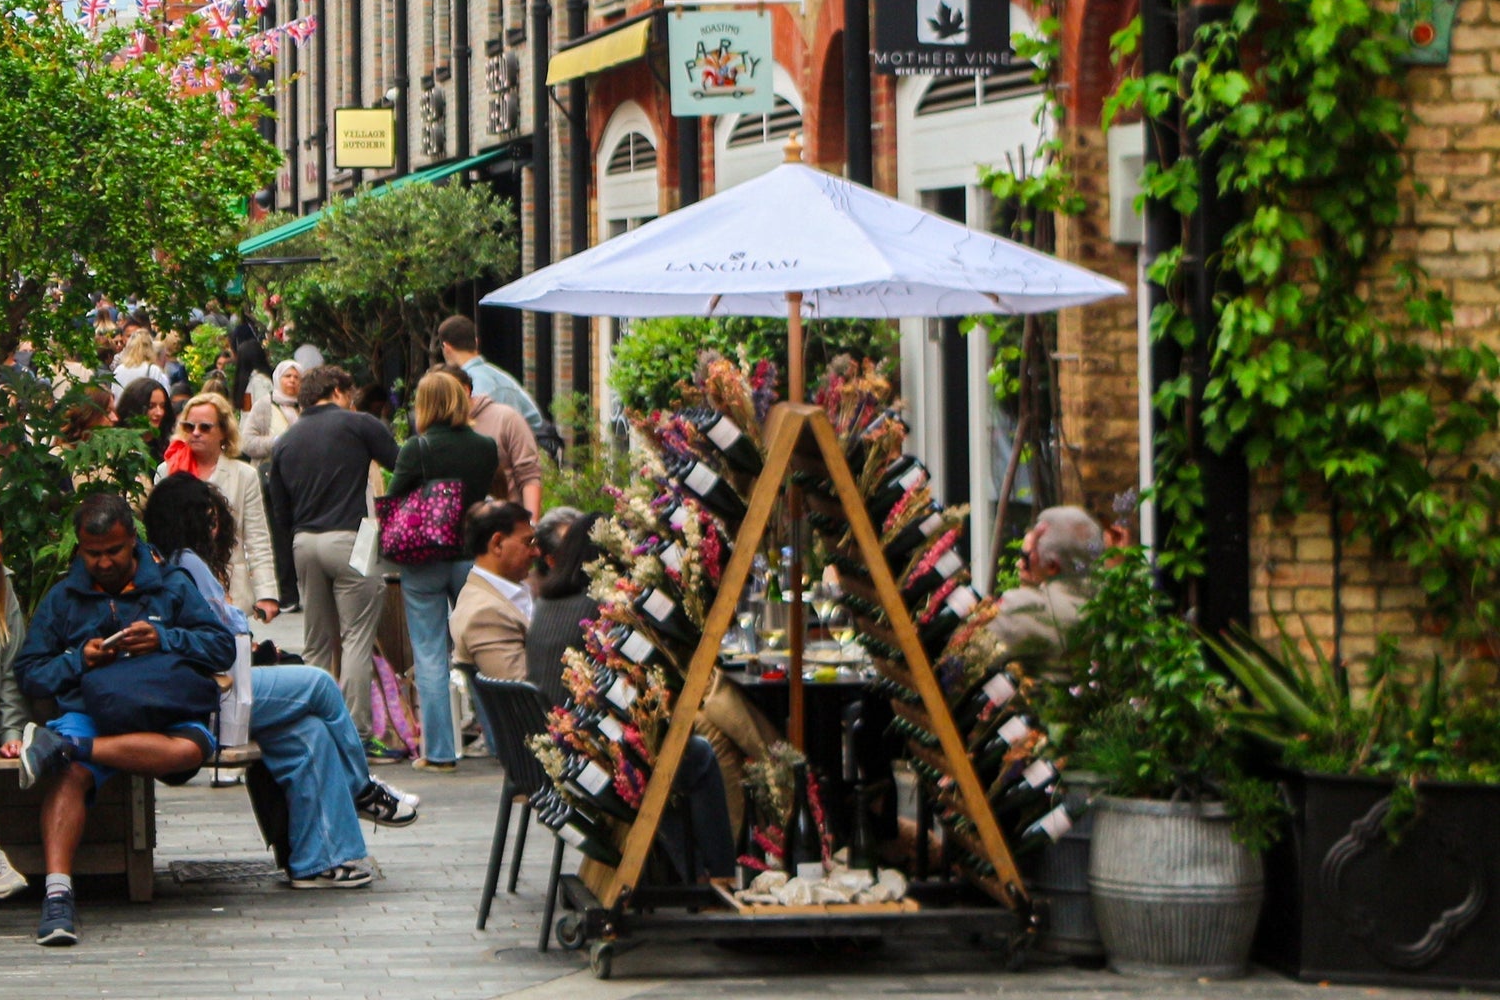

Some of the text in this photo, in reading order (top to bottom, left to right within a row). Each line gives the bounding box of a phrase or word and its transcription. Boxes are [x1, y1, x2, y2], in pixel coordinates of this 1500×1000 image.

[700, 23, 740, 36] ROASTING
[685, 39, 761, 82] PARTY
[874, 52, 1010, 65] MOTHER VINE
[343, 130, 385, 138] VILLAGE
[343, 141, 385, 149] BUTCHER
[664, 259, 799, 272] LANGHAM
